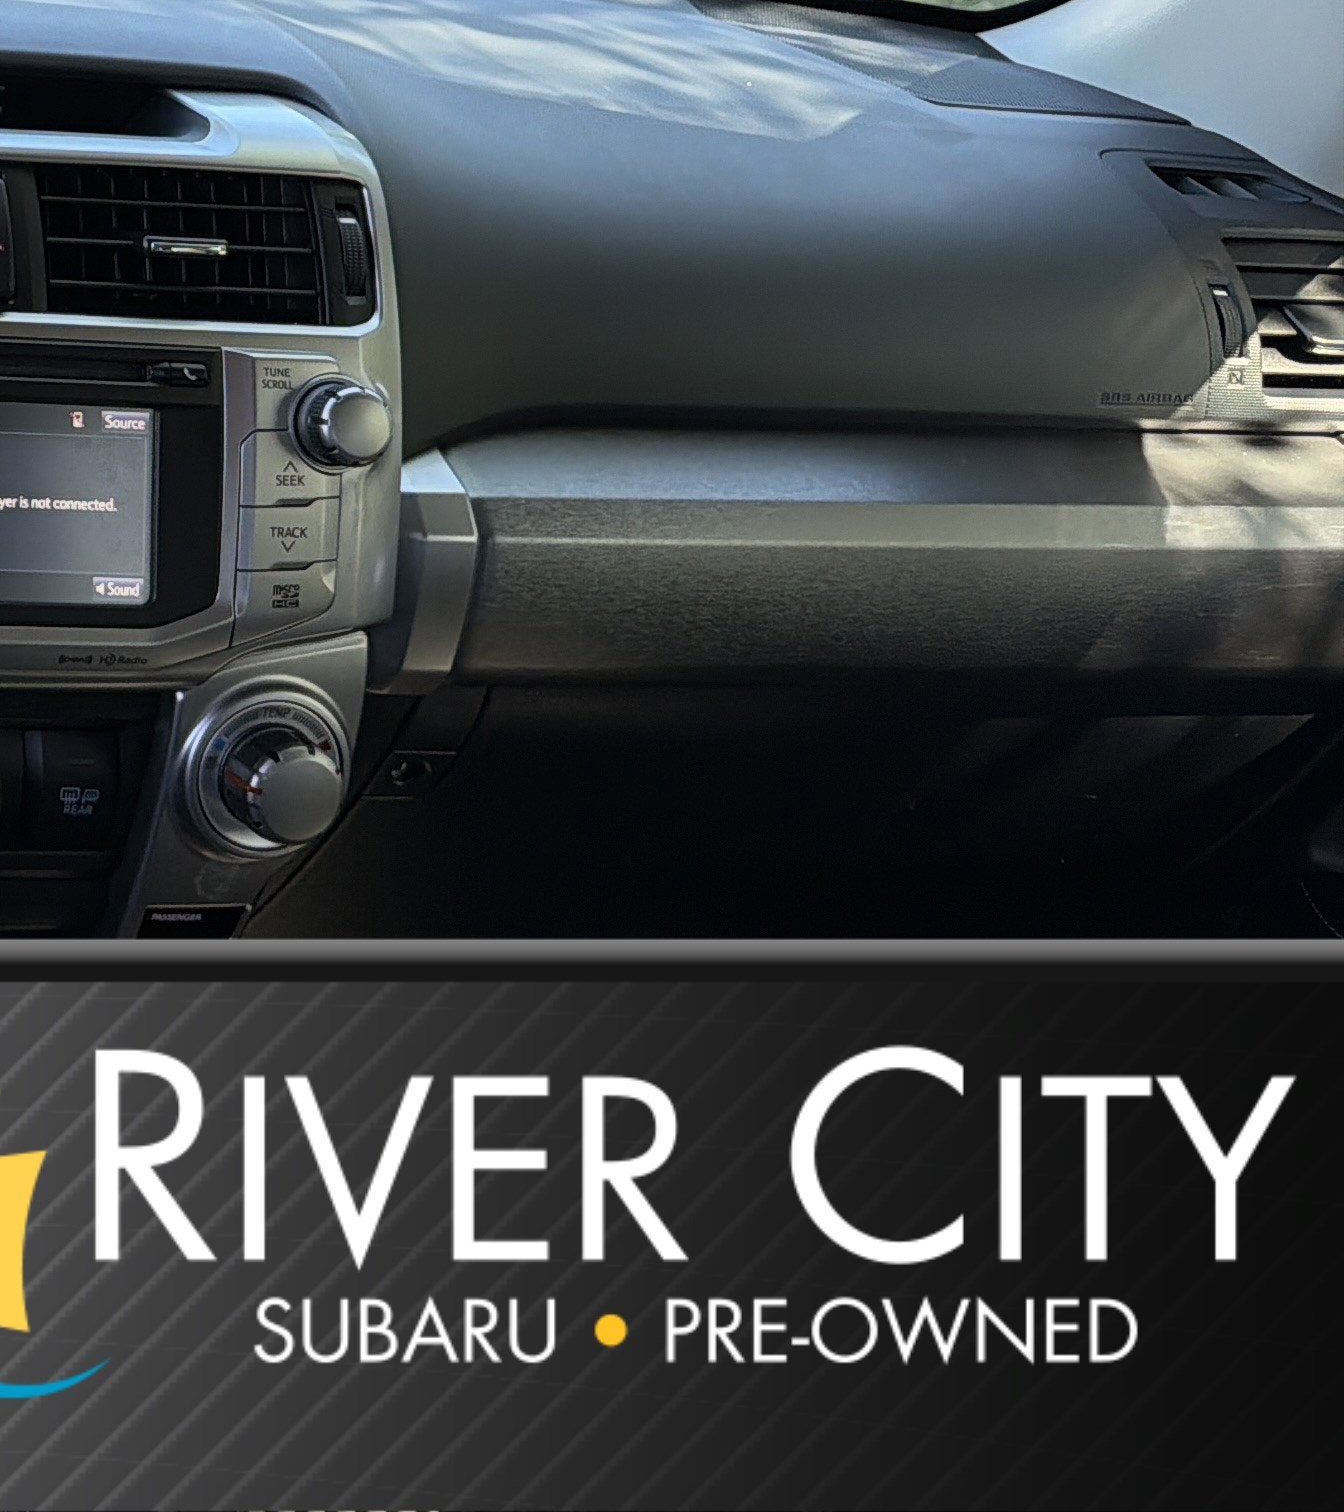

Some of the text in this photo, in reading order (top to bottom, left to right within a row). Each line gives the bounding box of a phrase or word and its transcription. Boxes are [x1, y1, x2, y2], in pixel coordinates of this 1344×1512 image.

[263, 366, 291, 378] TUNE
[261, 378, 293, 390] SCROLL
[104, 414, 146, 431] Source
[275, 474, 305, 487] SEEK
[18, 494, 30, 510] is
[30, 496, 52, 511] not
[52, 496, 118, 513] connected.
[269, 526, 308, 539] TRACK
[106, 581, 141, 598] Sound
